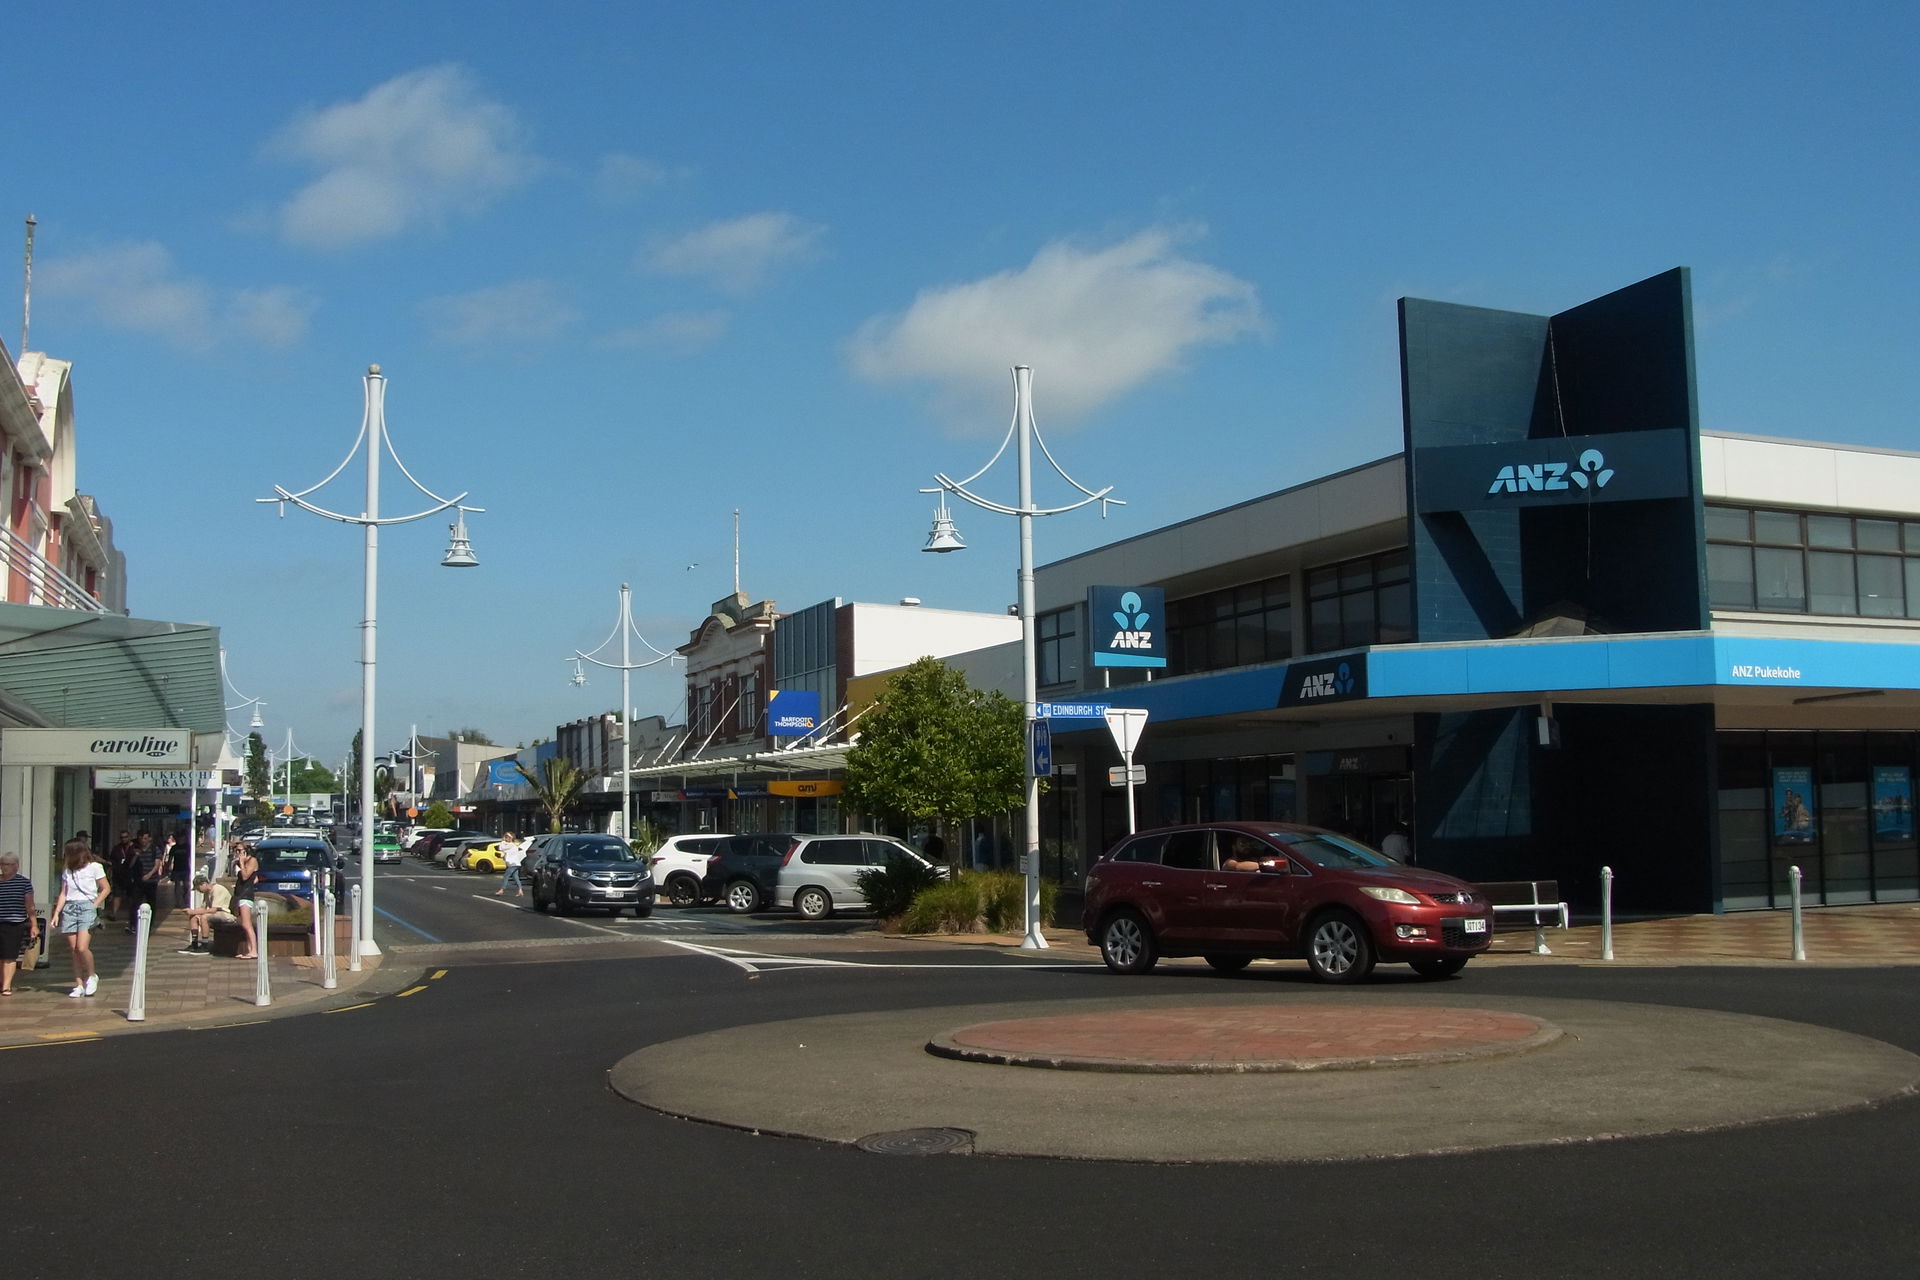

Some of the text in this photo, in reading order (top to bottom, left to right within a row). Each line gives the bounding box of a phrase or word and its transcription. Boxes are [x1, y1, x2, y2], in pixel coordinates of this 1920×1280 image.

[1488, 463, 1568, 493] ANZ
[1110, 631, 1152, 648] ANZ
[1732, 665, 1801, 679] ANZ Pukekohe
[1300, 673, 1335, 698] ANZ
[1053, 704, 1104, 716] EDINBURGH ST
[90, 736, 178, 753] caroline
[798, 784, 817, 792] ami
